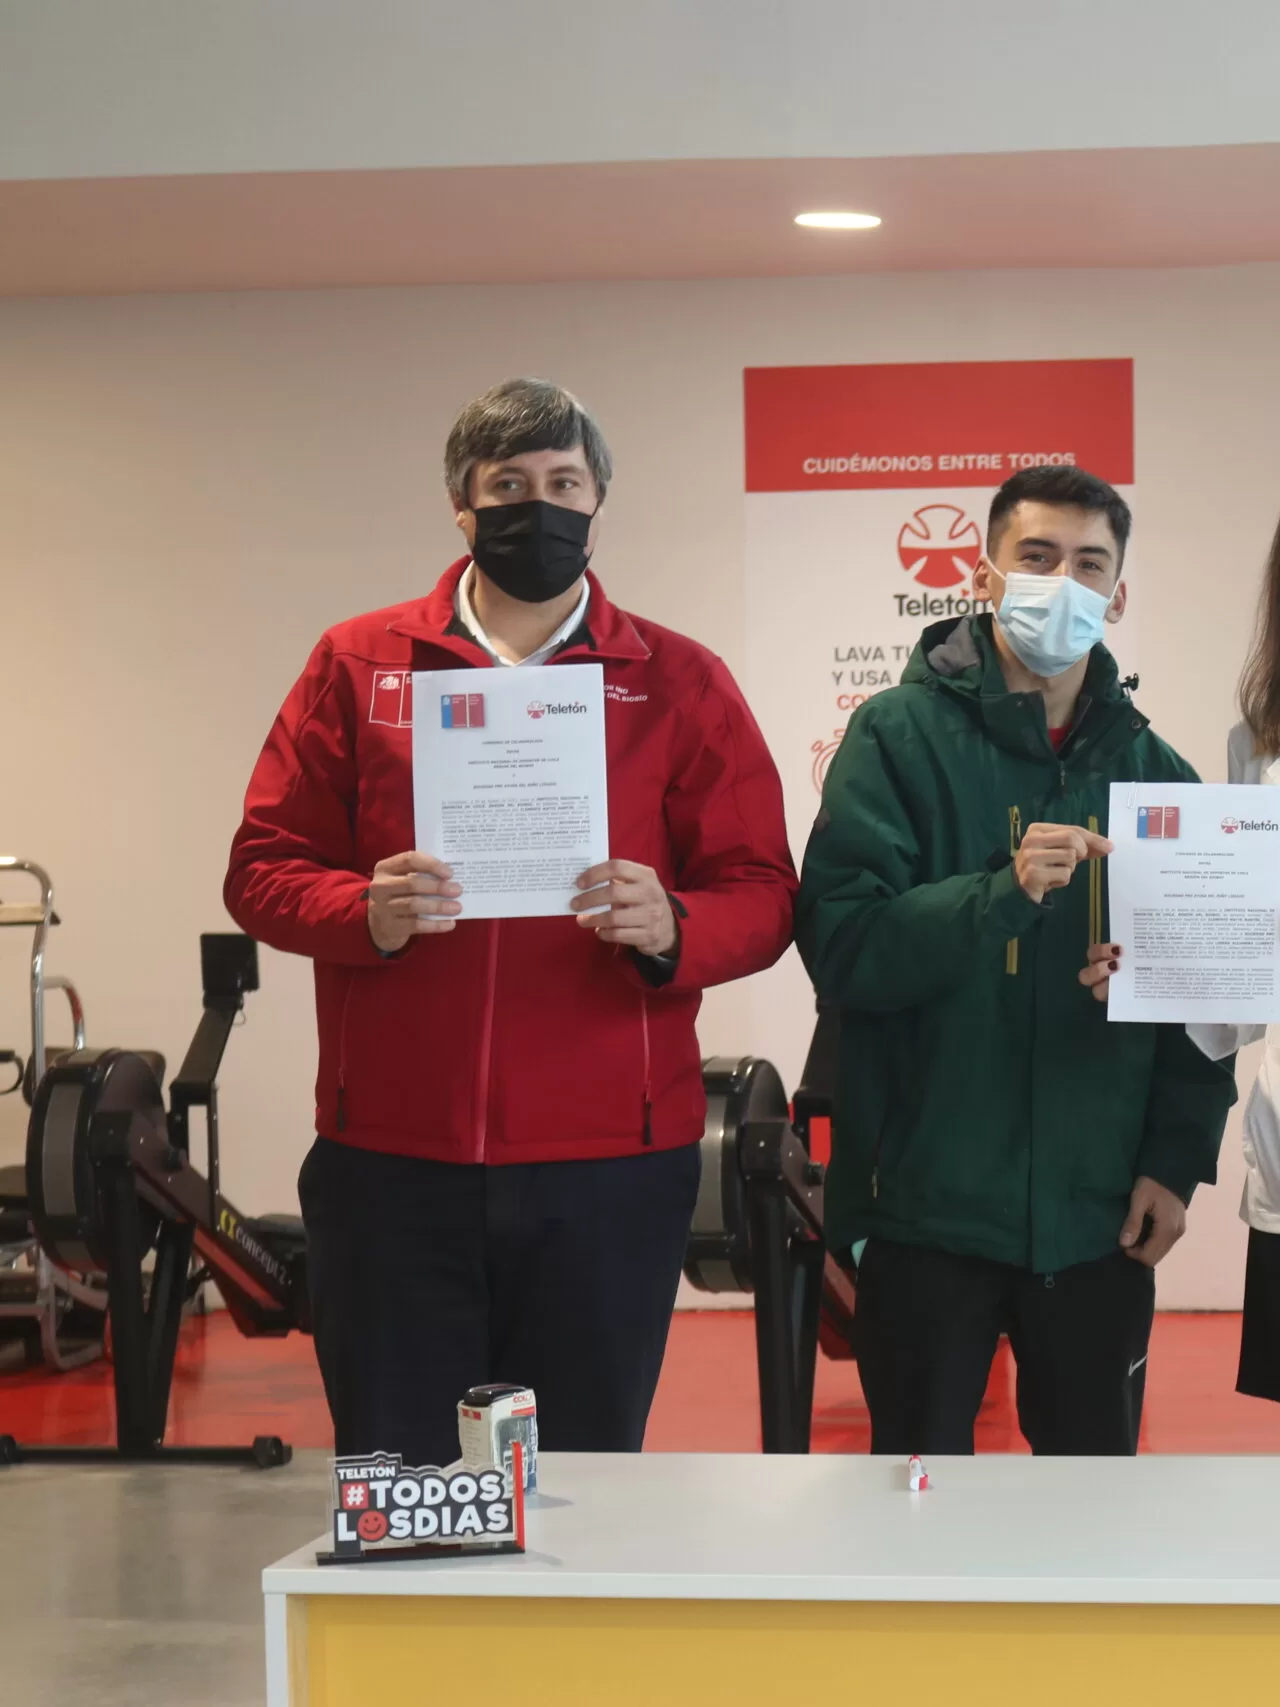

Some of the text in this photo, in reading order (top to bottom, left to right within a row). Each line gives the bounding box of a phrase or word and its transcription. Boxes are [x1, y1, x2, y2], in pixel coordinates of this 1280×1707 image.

[803, 453, 1076, 473] CUIDÉMONOS ENTRE TODOS
[834, 645, 885, 662] LAVA
[831, 670, 892, 686] Y USA
[545, 701, 587, 715] Teletón
[836, 693, 872, 711] CO
[1239, 819, 1279, 832] Teletón
[337, 1463, 396, 1480] TELETÓN
[345, 1473, 505, 1509] #TODOS
